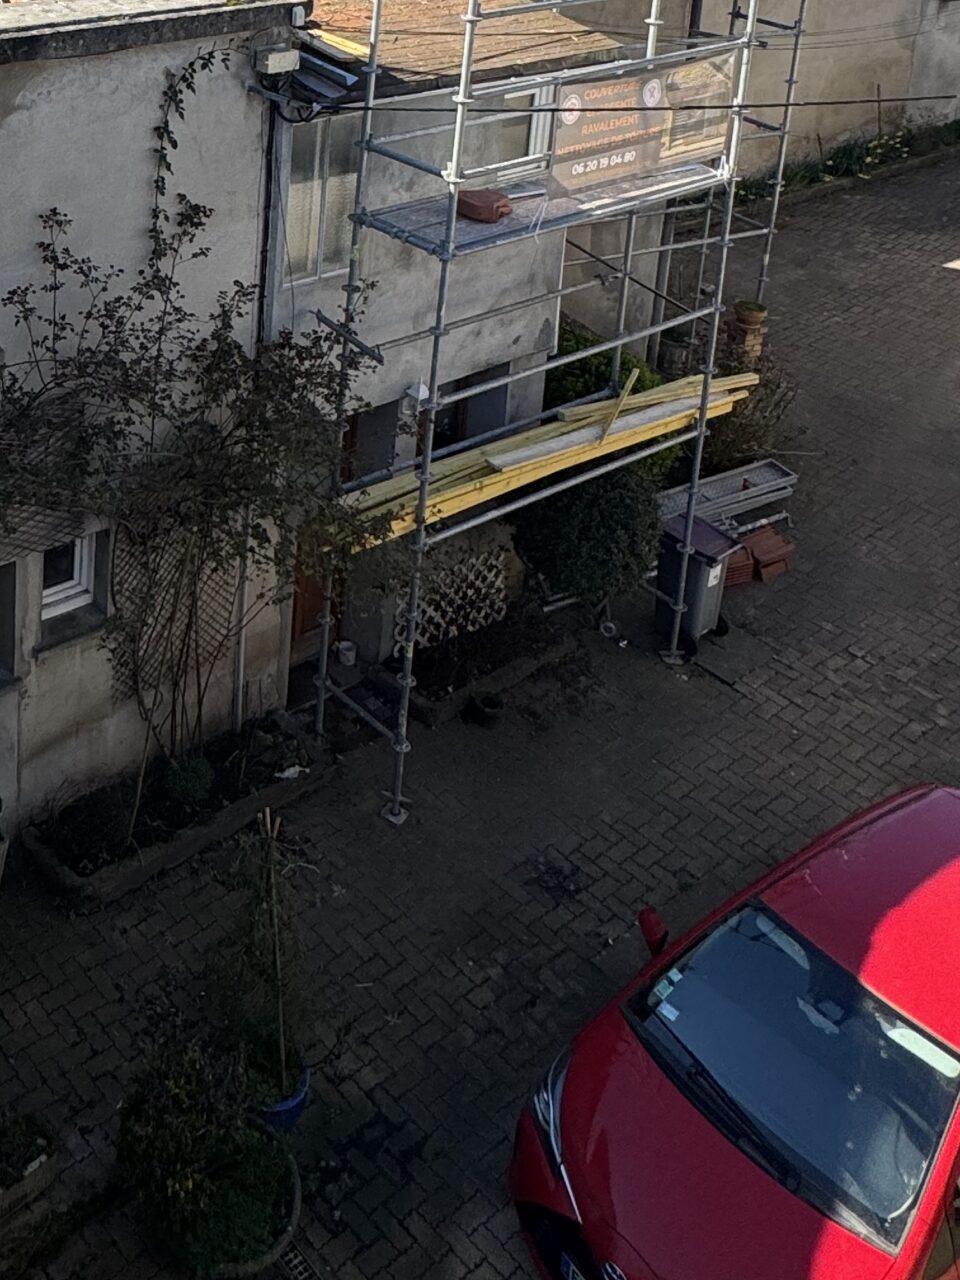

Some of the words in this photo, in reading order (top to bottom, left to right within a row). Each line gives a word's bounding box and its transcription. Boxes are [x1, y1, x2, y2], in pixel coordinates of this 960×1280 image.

[584, 81, 642, 99] COUVERTURE
[582, 114, 641, 135] RAVALEMENT
[572, 164, 585, 175] 06
[585, 159, 598, 172] 20
[599, 157, 609, 169] 19
[610, 154, 623, 166] 04
[623, 151, 636, 162] 80
